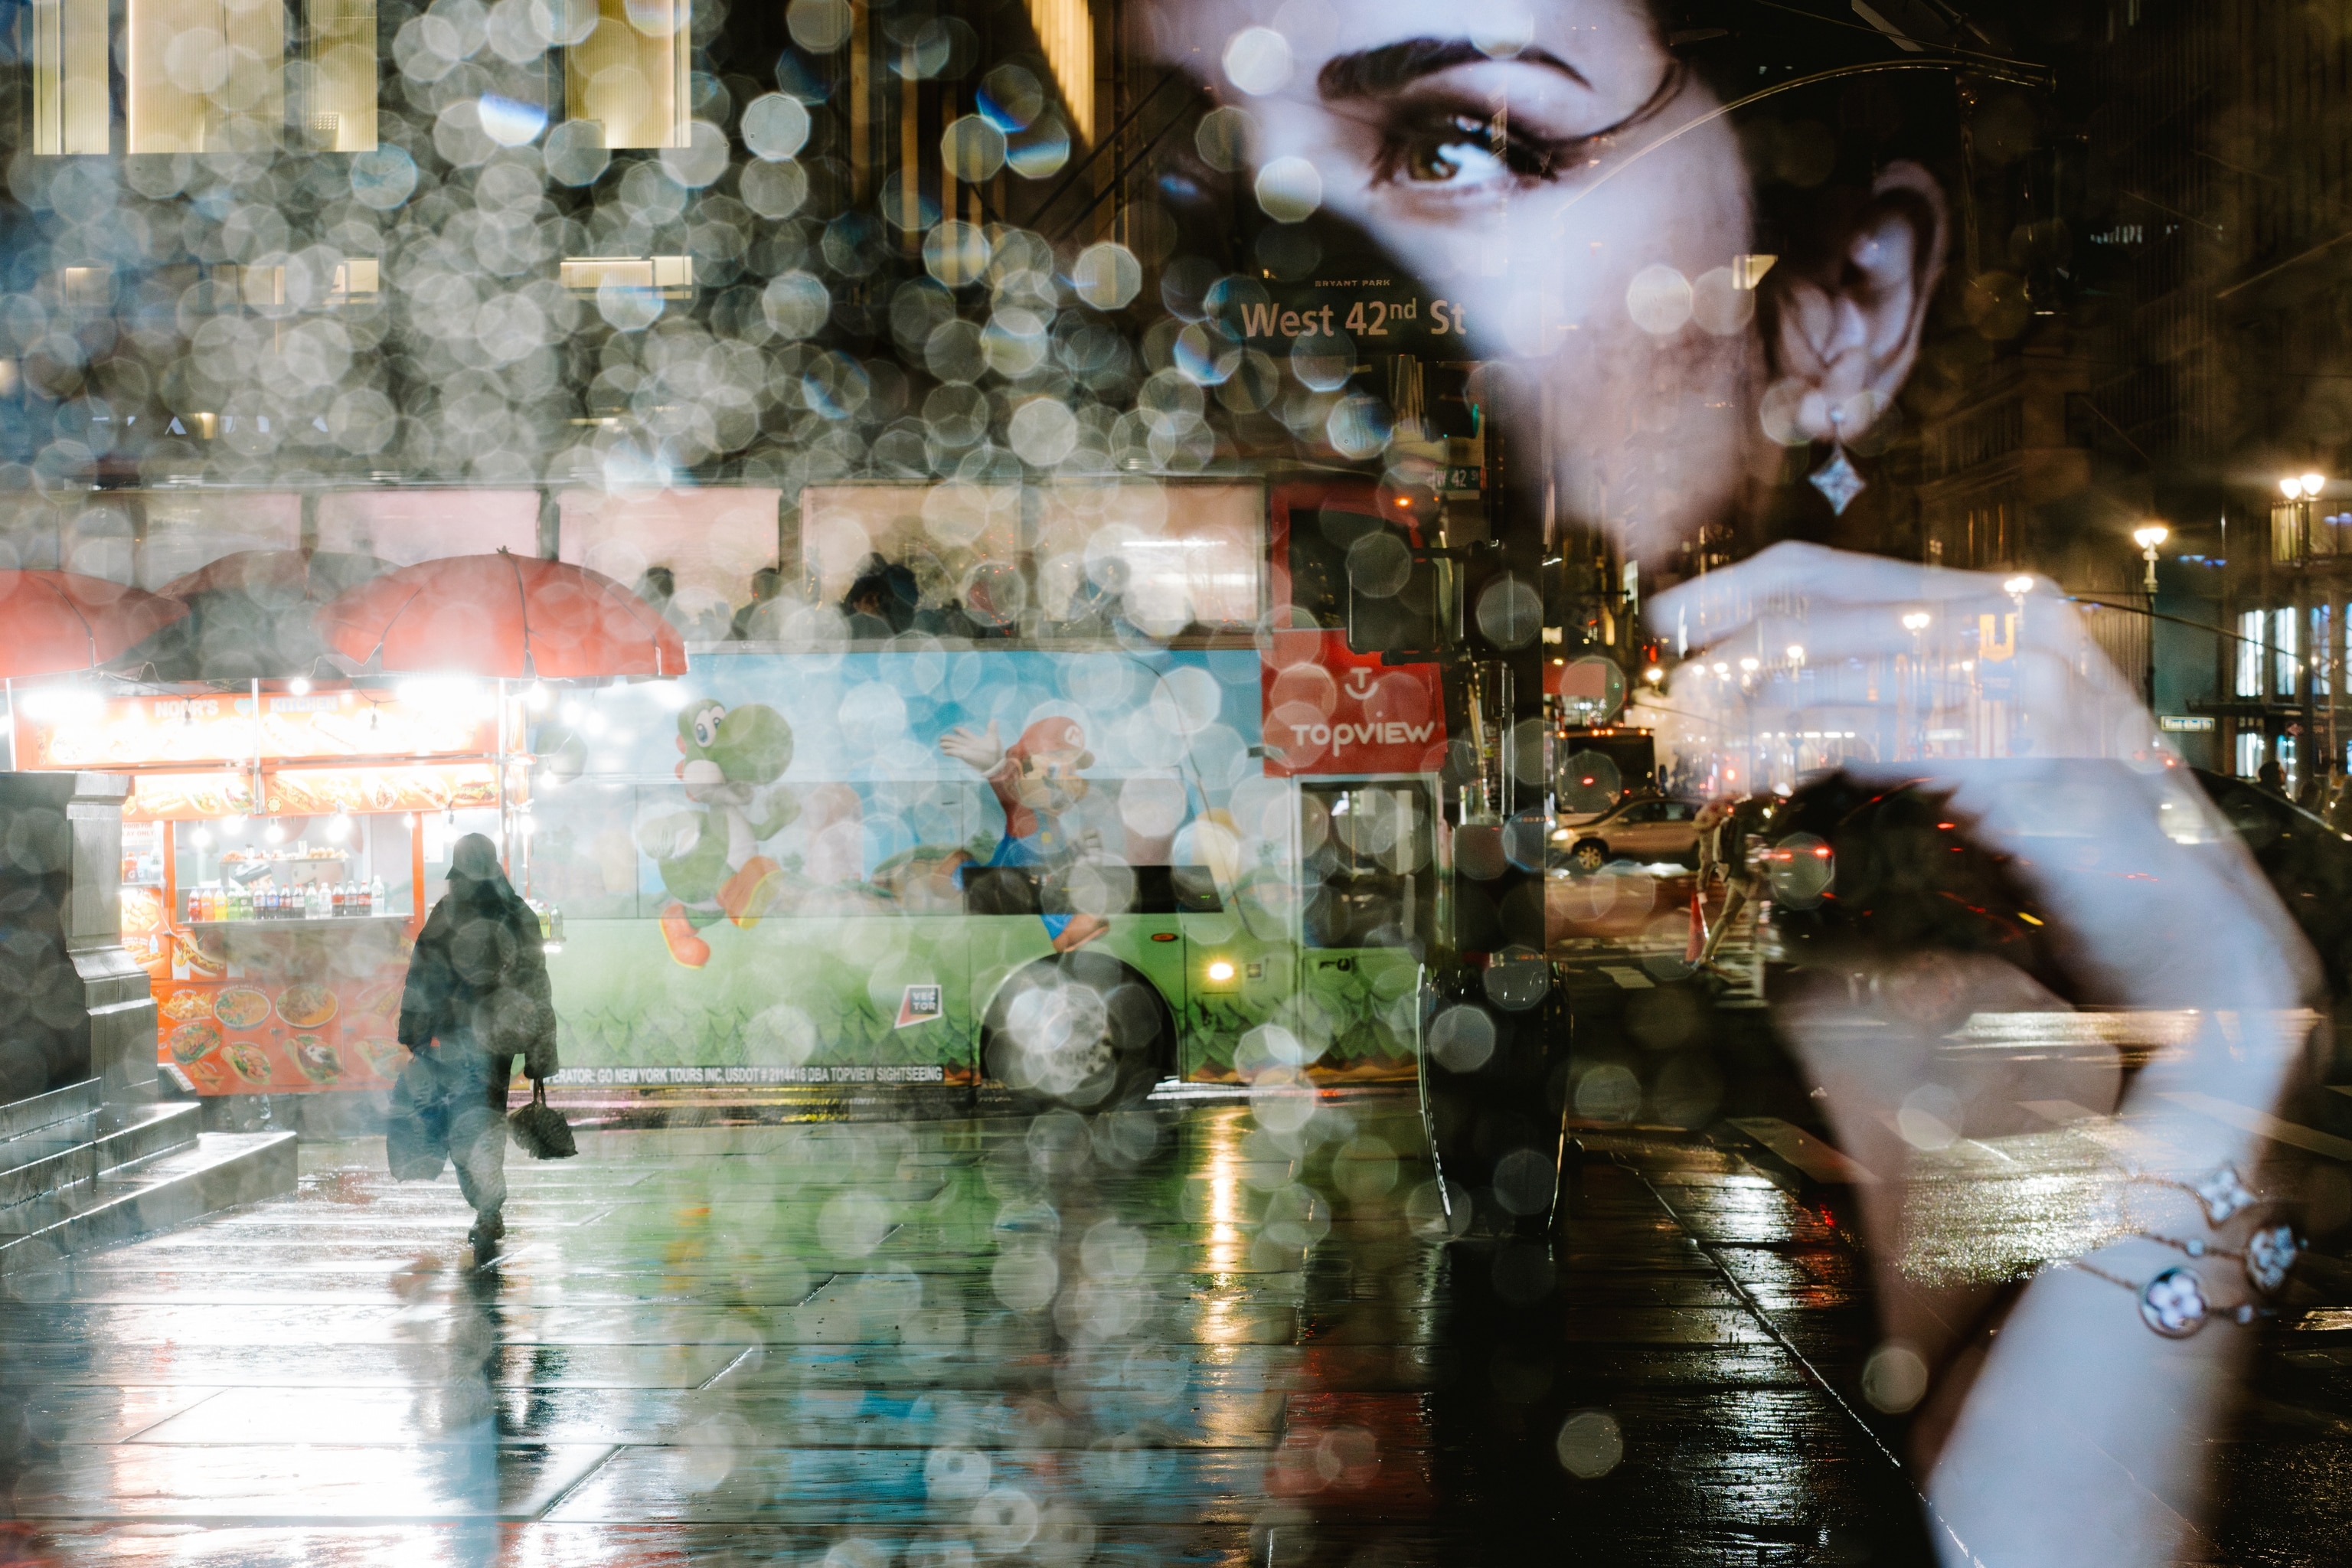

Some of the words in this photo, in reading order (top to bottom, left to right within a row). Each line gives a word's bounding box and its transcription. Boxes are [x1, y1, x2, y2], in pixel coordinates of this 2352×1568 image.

[1240, 302, 1334, 337] West
[1345, 298, 1416, 335] 42nd
[1430, 299, 1466, 335] St
[1451, 469, 1467, 488] 42
[269, 696, 338, 713] KITCHEN
[597, 1067, 612, 1083] GO
[615, 1067, 638, 1083] NEW
[639, 1067, 668, 1083] YORK
[669, 1067, 703, 1083] TOURS
[725, 1067, 760, 1083] USDOT
[808, 1067, 829, 1082] DBA
[830, 1067, 875, 1082] TOPVIEW
[876, 1066, 943, 1082] SIGHTSEEING
